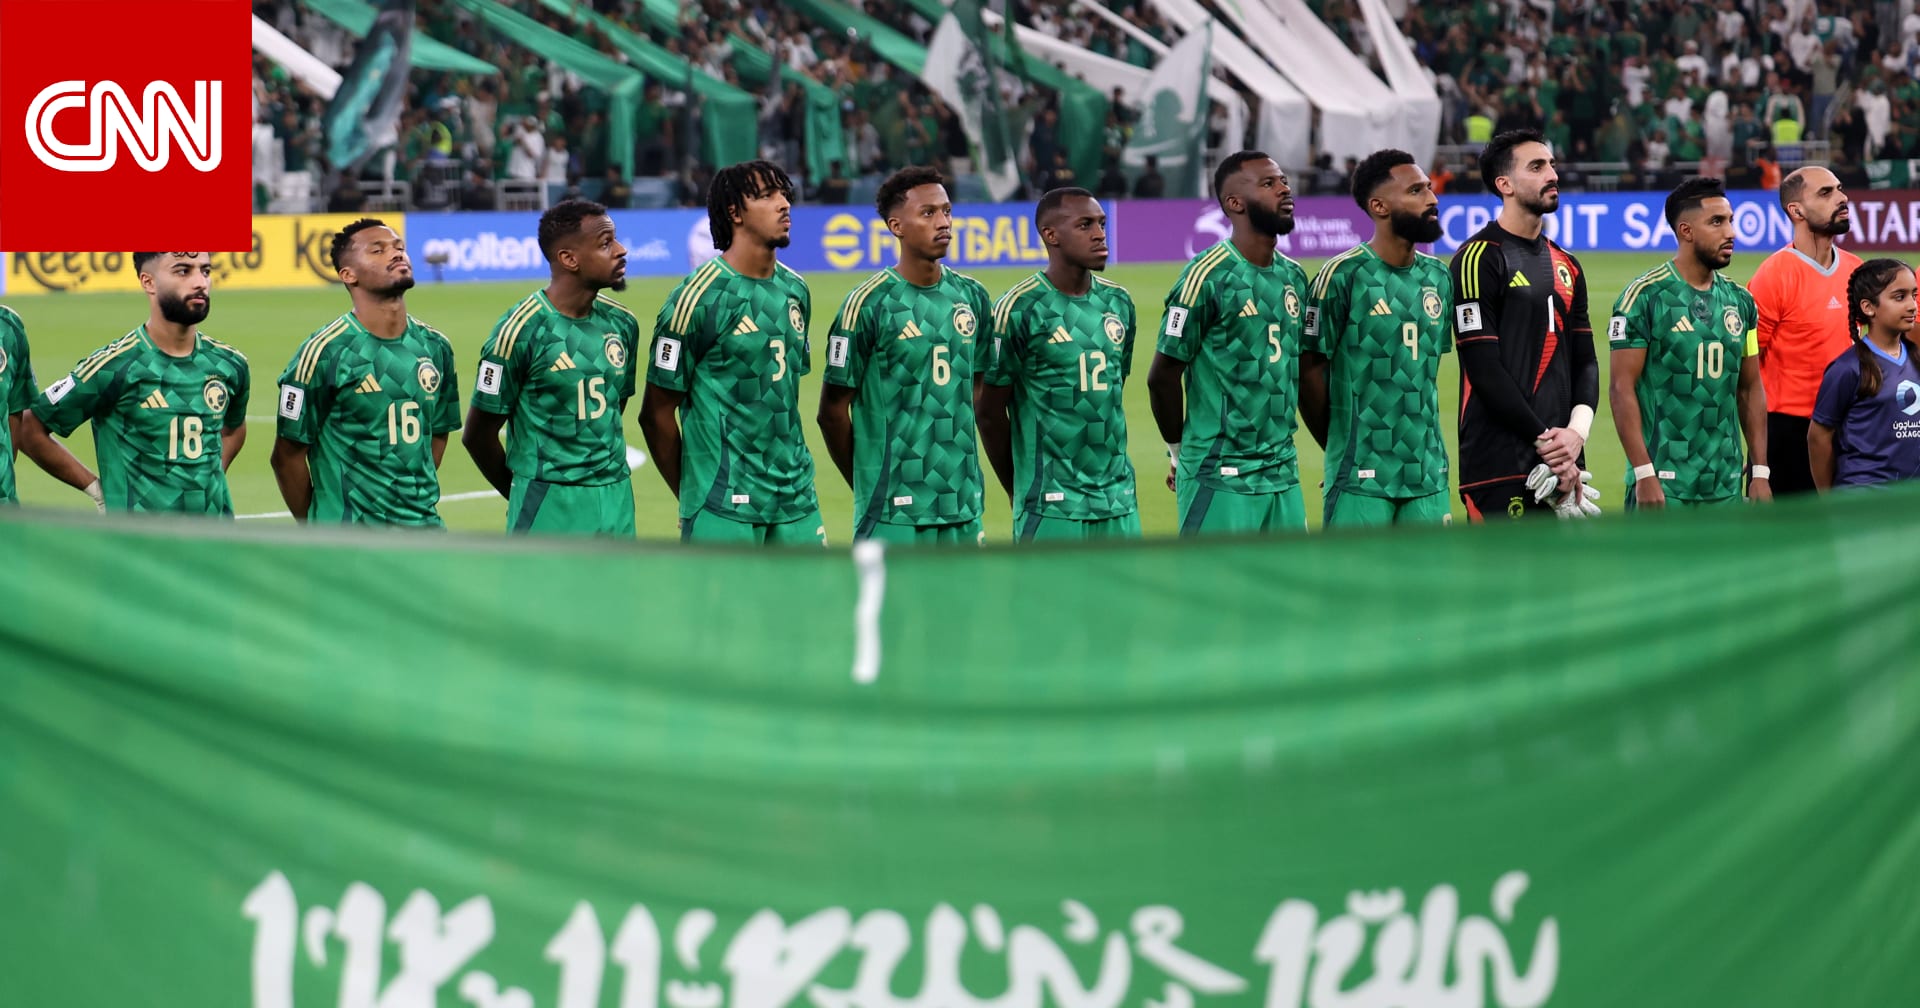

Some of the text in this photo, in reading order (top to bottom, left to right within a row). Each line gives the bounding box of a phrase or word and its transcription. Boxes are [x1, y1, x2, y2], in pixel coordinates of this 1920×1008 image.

[1622, 202, 1793, 248] SAON
[422, 232, 542, 270] molten
[1547, 294, 1555, 333] 1
[769, 339, 786, 382] 3
[1268, 324, 1282, 363] 5
[1402, 322, 1418, 361] 9
[1697, 341, 1724, 379] 10
[932, 345, 951, 386] 6
[1079, 351, 1108, 392] 12
[577, 376, 607, 420] 15
[168, 416, 203, 460] 18
[388, 401, 420, 445] 16
